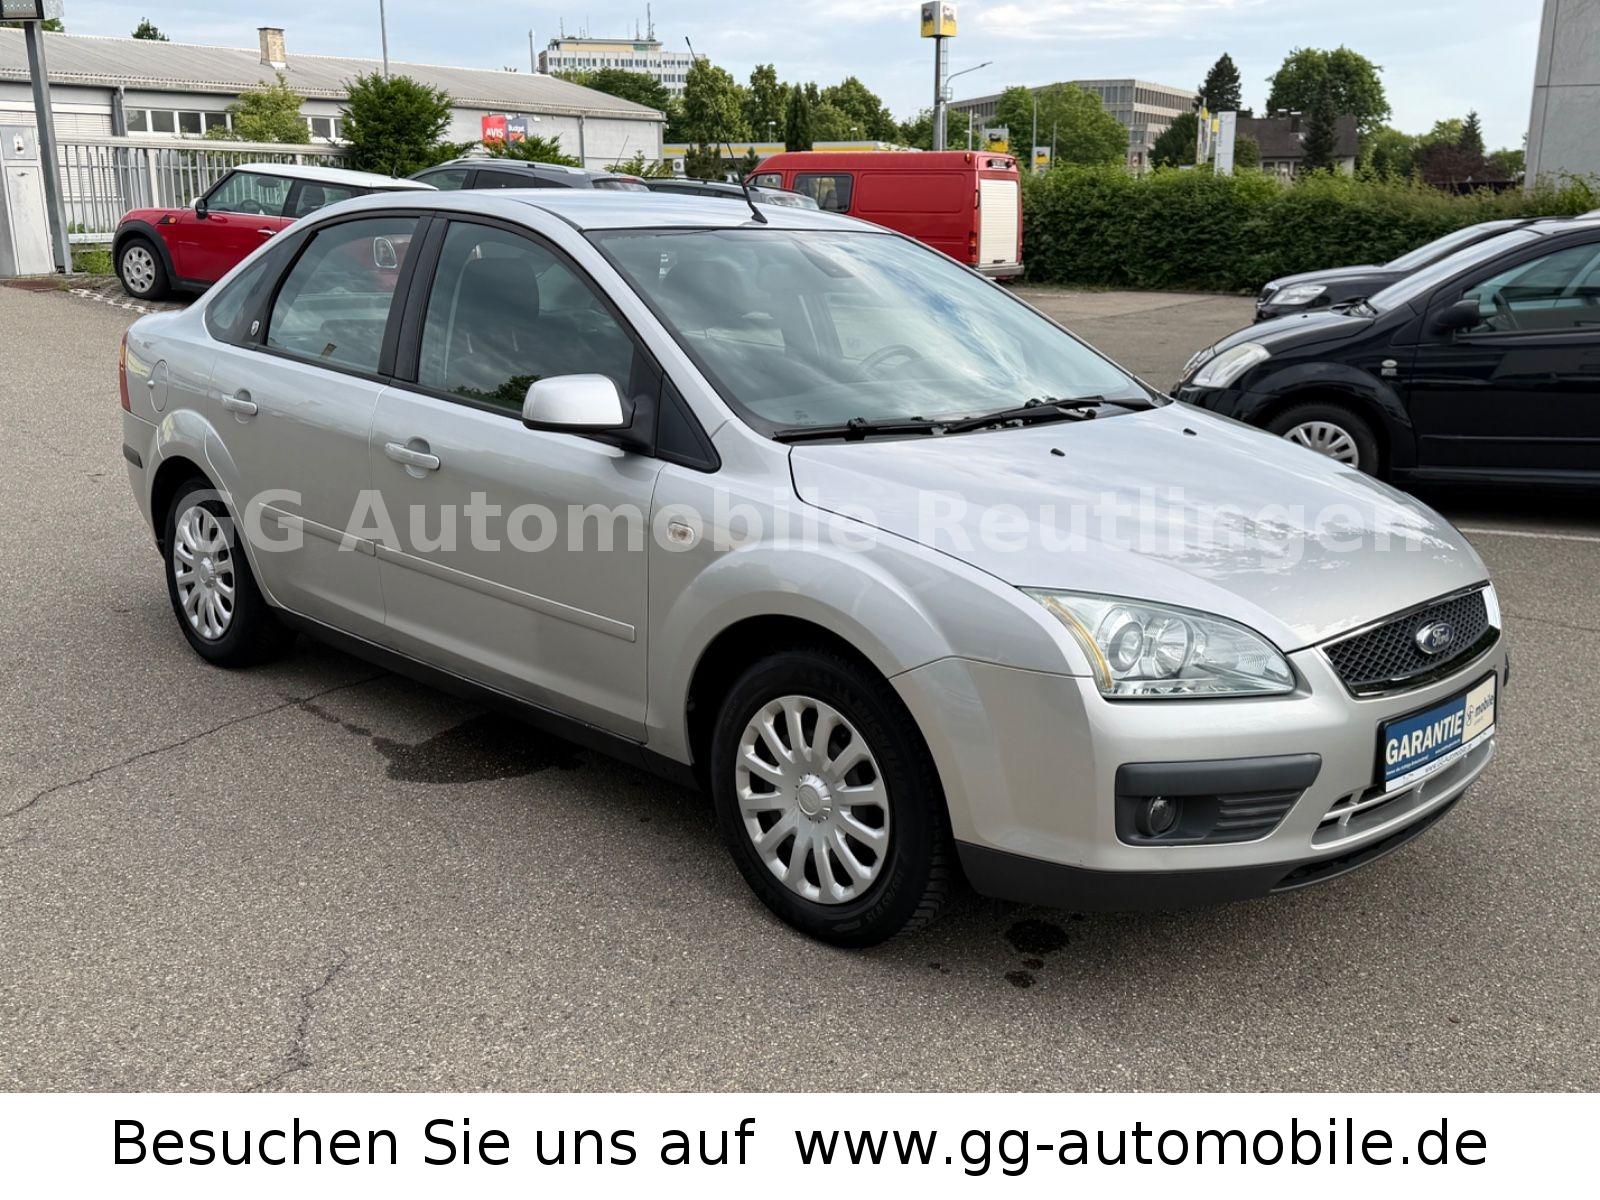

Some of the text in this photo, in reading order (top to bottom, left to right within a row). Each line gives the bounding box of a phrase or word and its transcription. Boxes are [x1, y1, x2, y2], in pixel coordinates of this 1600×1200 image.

[486, 127, 504, 138] AVIS
[1432, 626, 1450, 647] Ford
[1386, 709, 1465, 765] GARANTIE
